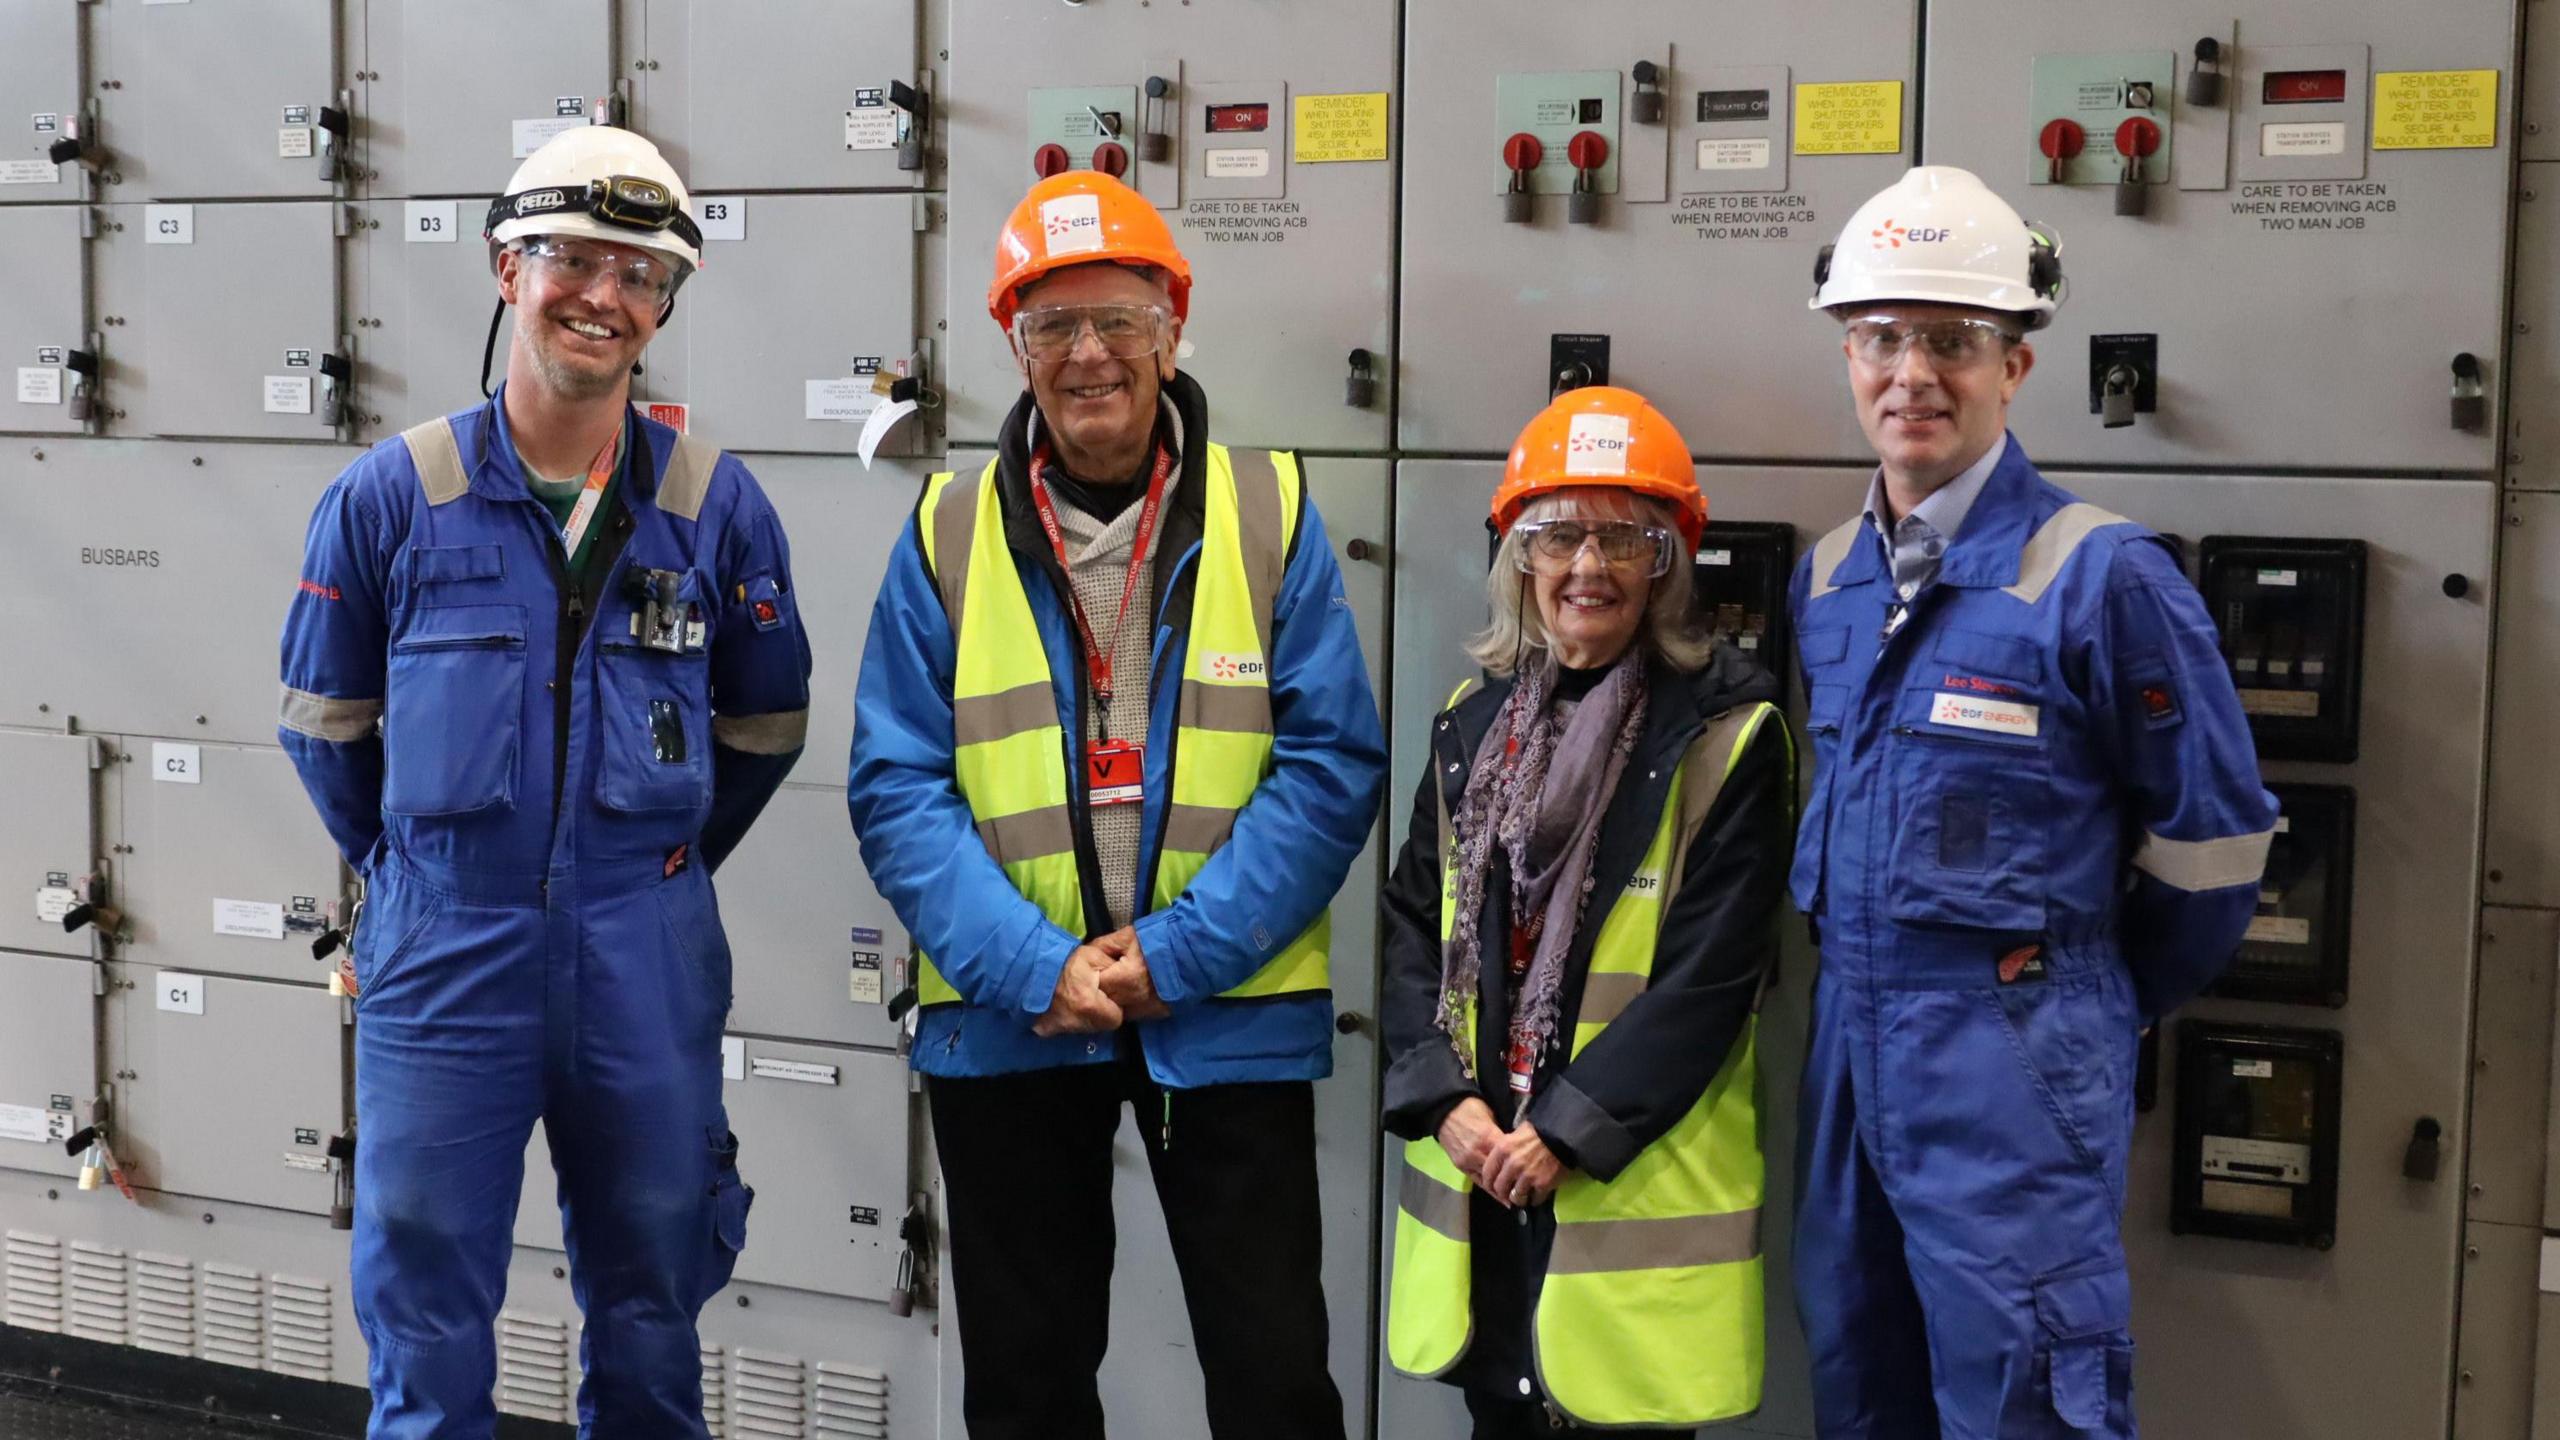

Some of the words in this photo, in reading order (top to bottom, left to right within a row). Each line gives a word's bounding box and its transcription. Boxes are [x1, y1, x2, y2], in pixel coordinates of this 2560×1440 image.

[2299, 81, 2319, 91] ON
[2400, 75, 2469, 87] REMINDER
[1818, 86, 1878, 97] REMINDER
[2388, 90, 2420, 100] WHEN
[2428, 88, 2479, 99] ISOLATING
[1313, 97, 1367, 109] REMINDER
[1808, 100, 1835, 109] WHEN
[1842, 98, 1887, 108] ISOLATING
[2396, 101, 2448, 111] SHUTTERS
[2457, 100, 2472, 110] ON
[1235, 113, 1251, 123] ON
[1304, 111, 1329, 120] WHEN
[1335, 108, 1374, 118] ISOLATING
[1814, 110, 1861, 120] SHUTTERS
[1867, 109, 1880, 119] ON
[2422, 112, 2477, 122] BREAKERS
[1311, 120, 1352, 129] SHUTTERS
[1356, 119, 1369, 128] ON
[1837, 120, 1884, 130] BREAKERS
[2405, 124, 2444, 134] SECURE
[1331, 128, 1372, 138] BREAKERS
[1822, 131, 1856, 141] SECURE
[1318, 140, 1349, 149] SECURE
[2375, 136, 2418, 146] PADLOCK
[2428, 135, 2454, 145] BOTH
[2462, 134, 2490, 145] SIDES
[1796, 142, 1834, 152] PADLOCK
[1841, 142, 1865, 151] BOTH
[1872, 141, 1897, 151] SIDES
[1296, 151, 1329, 160] PADLOCK
[1336, 150, 1356, 159] BOTH
[1361, 149, 1385, 158] SIDES
[2242, 186, 2282, 198] CARE
[2288, 185, 2307, 197] TO
[2312, 185, 2331, 197] BE
[2336, 184, 2386, 196] TAKEN
[517, 191, 566, 216] PETZL
[1190, 203, 1220, 214] CARE
[1224, 203, 1240, 213] TO
[1243, 203, 1258, 213] BE
[1261, 203, 1300, 213] TAKEN
[1681, 198, 1716, 209] CARE
[1721, 197, 1737, 208] TO
[1741, 197, 1758, 208] BE
[1763, 196, 1806, 207] TAKEN
[2232, 202, 2275, 214] WHEN
[2280, 201, 2361, 213] REMOVING
[2365, 200, 2396, 212] ACB
[705, 203, 728, 221] E3
[1672, 214, 1710, 225] WHEN
[1714, 212, 1784, 224] REMOVING
[1788, 211, 1815, 222] ACB
[159, 219, 179, 234] C3
[420, 217, 441, 232] D3
[1182, 218, 1216, 228] WHEN
[1219, 217, 1281, 228] REMOVING
[1284, 217, 1308, 227] ACB
[2260, 218, 2294, 230] TWO
[2299, 218, 2332, 229] MAN
[2336, 217, 2365, 229] JOB
[1204, 232, 1231, 242] TWO
[1234, 232, 1259, 242] MAN
[1262, 232, 1284, 242] JOB
[1697, 228, 1727, 239] TWO
[1731, 228, 1759, 238] MAN
[1763, 227, 1788, 238] JOB
[1157, 452, 1170, 479] VISIT
[1041, 505, 1060, 543] VISITOR
[1140, 500, 1156, 539] VISITOR
[81, 547, 160, 567] BUSBARS
[1984, 711, 2033, 725] ENERGY
[167, 759, 186, 773] C2
[1093, 759, 1112, 778] V
[170, 989, 189, 1003] C1
